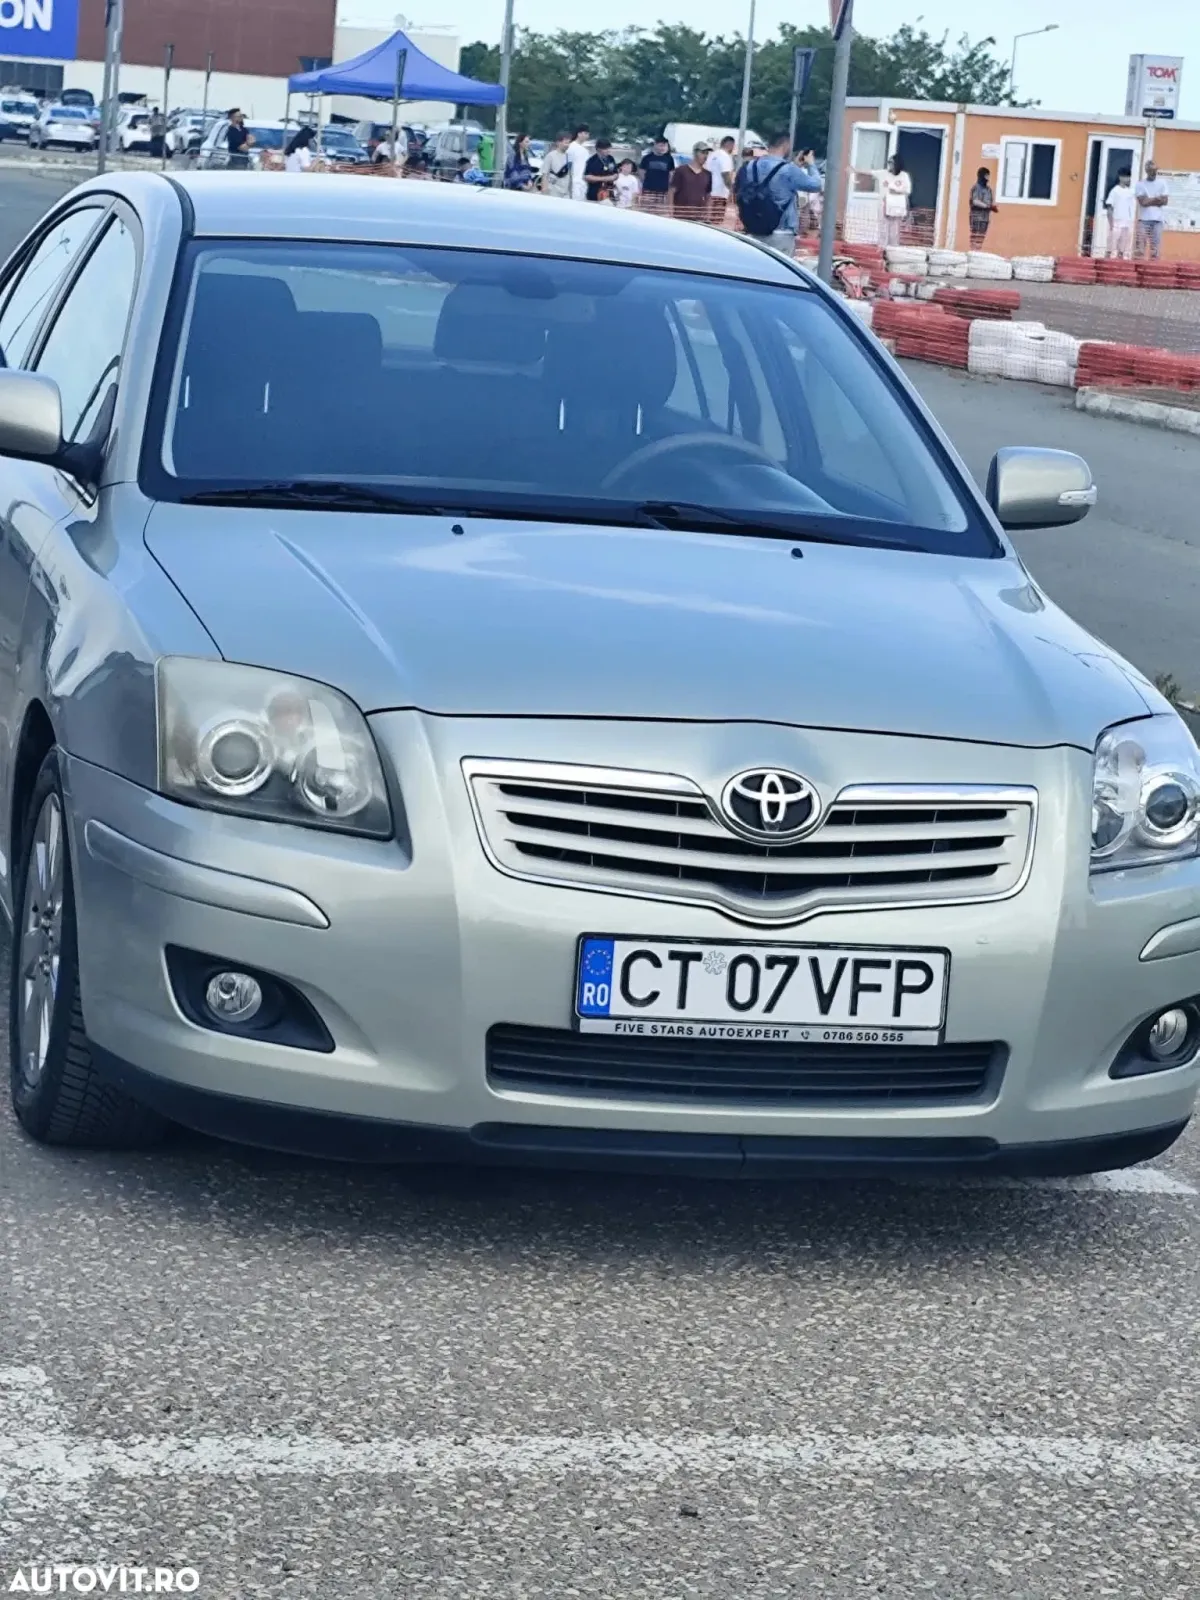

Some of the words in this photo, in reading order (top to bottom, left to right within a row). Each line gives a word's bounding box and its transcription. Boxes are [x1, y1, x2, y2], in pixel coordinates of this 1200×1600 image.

[583, 983, 608, 1006] RO
[620, 949, 703, 1010] CT
[725, 953, 800, 1013] 07
[808, 955, 934, 1017] VFP
[615, 1023, 644, 1034] FIVE
[650, 1024, 694, 1036] STARS
[699, 1027, 790, 1039] AUTOEXPERT
[823, 1031, 853, 1041] 0786
